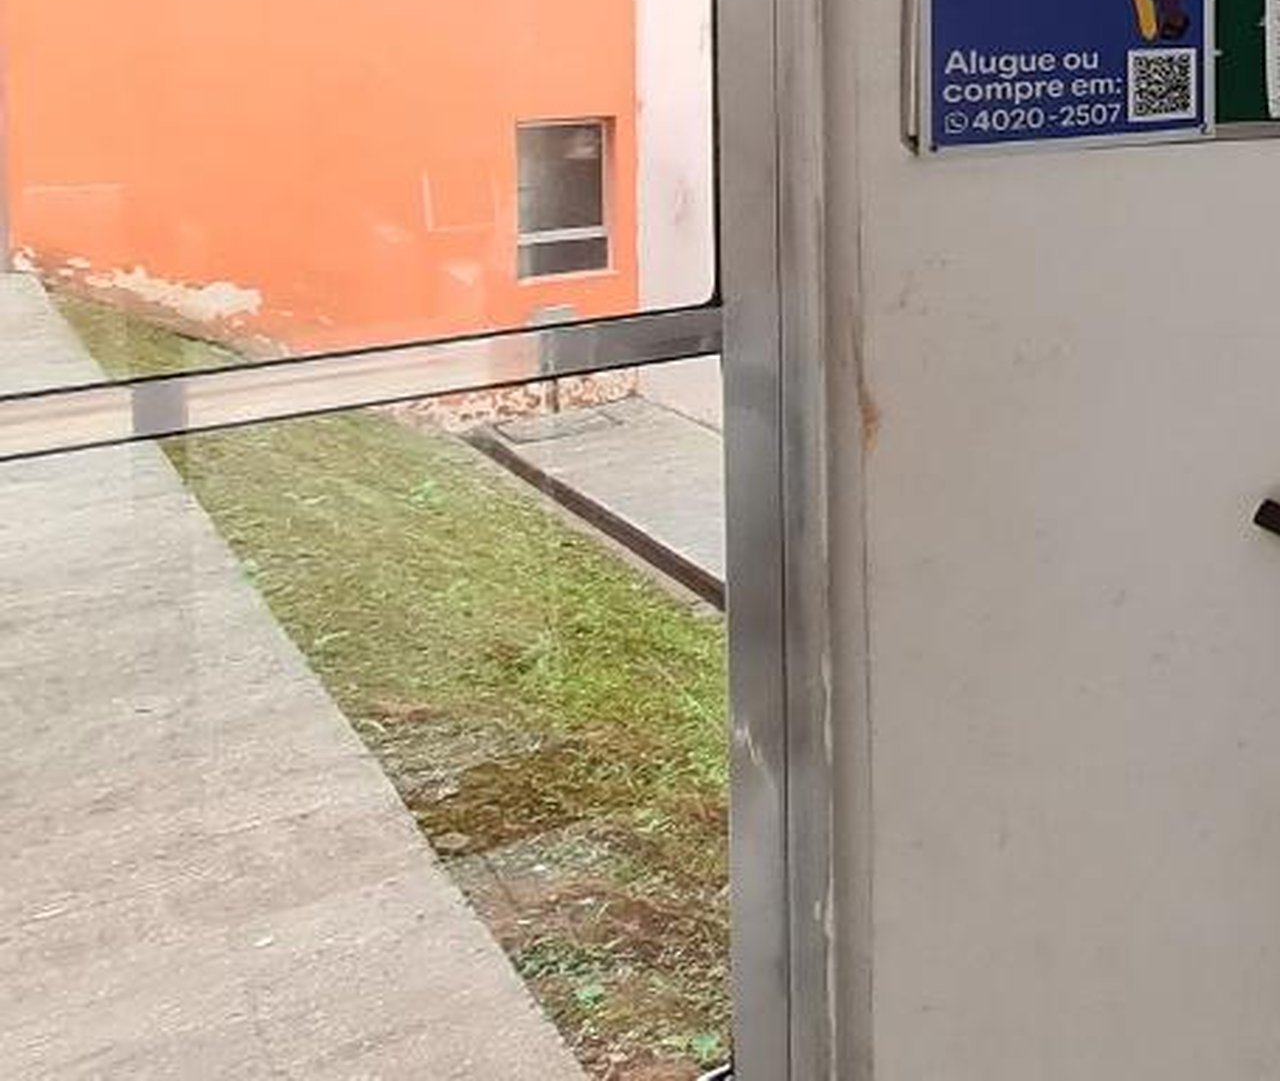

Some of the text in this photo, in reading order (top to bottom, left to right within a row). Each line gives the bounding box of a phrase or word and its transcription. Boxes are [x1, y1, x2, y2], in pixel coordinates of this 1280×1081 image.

[944, 50, 1099, 80] Alugue ou
[942, 76, 1123, 104] compre em:
[972, 104, 1122, 132] 4020-2507
